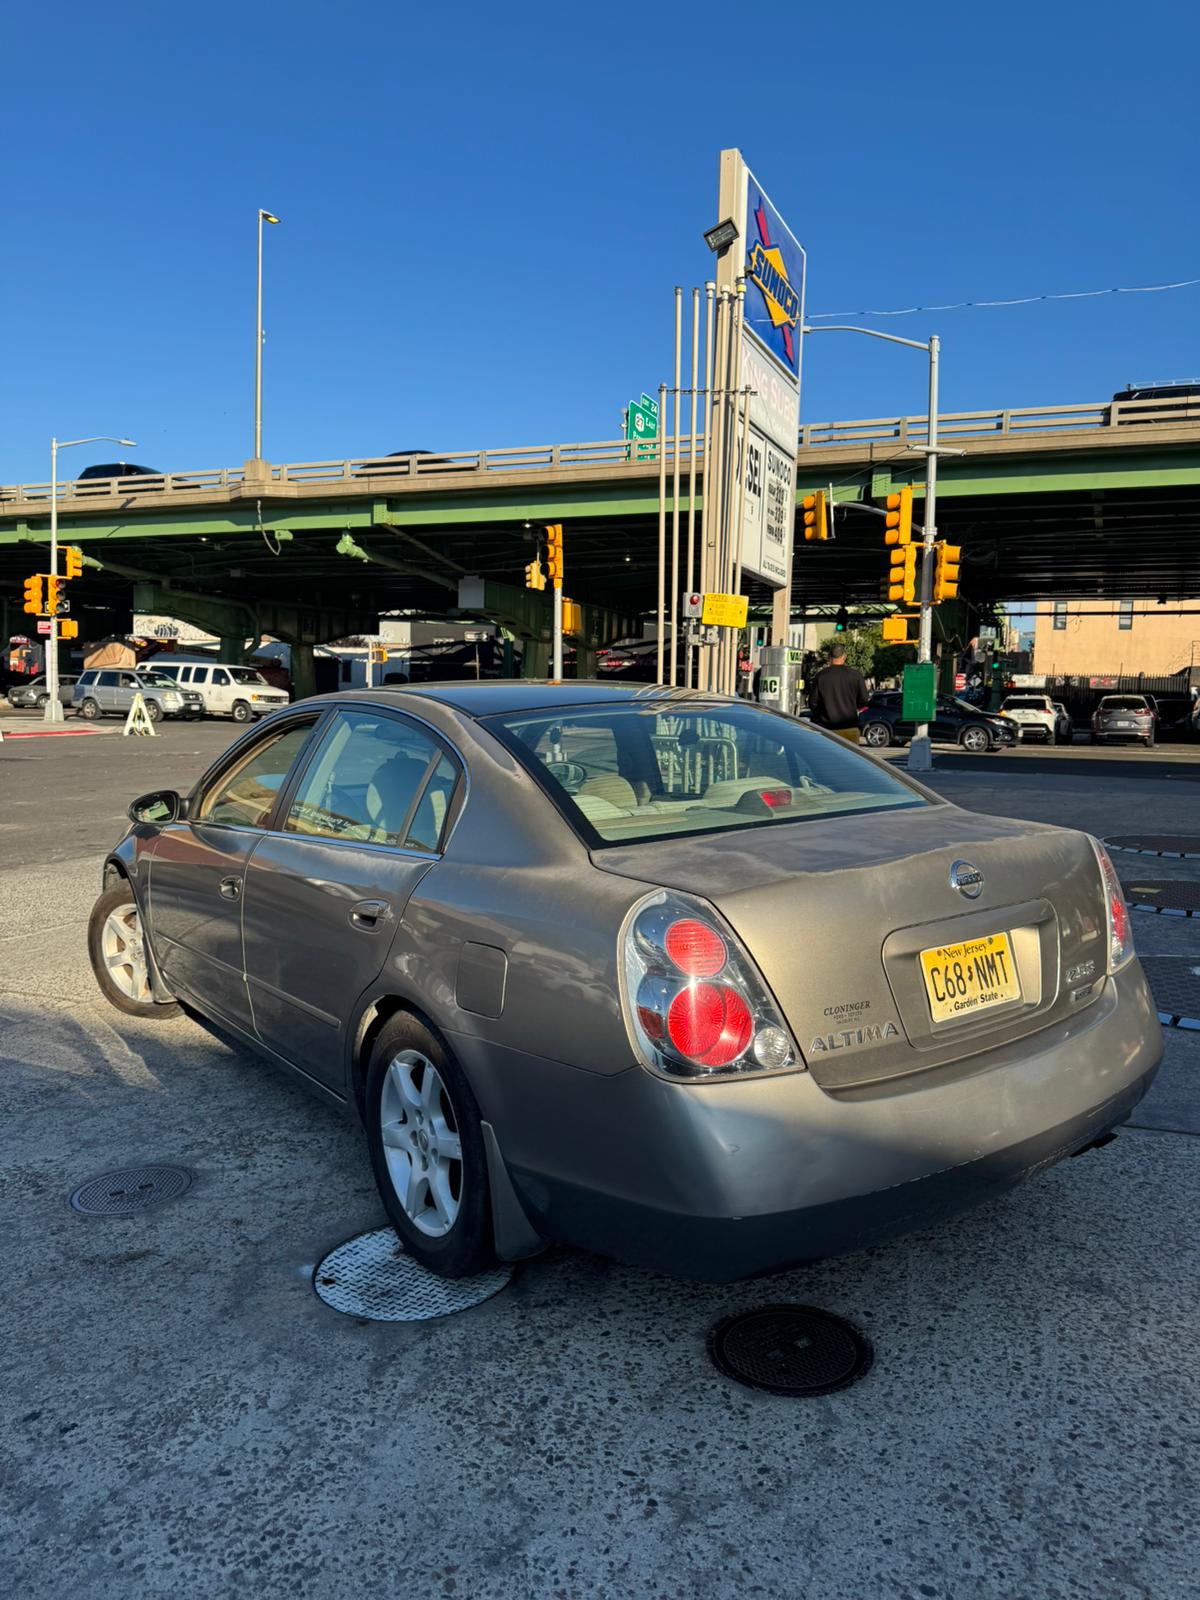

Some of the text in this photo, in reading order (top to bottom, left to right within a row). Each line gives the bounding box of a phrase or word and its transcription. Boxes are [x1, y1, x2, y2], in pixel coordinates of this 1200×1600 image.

[754, 248, 799, 317] SUNOCO
[768, 450, 791, 486] SUNOCO
[943, 942, 987, 960] New Jersey
[823, 1000, 871, 1017] CLONINGER
[954, 991, 999, 1011] Garden State
[808, 1021, 900, 1055] ALTIMA
